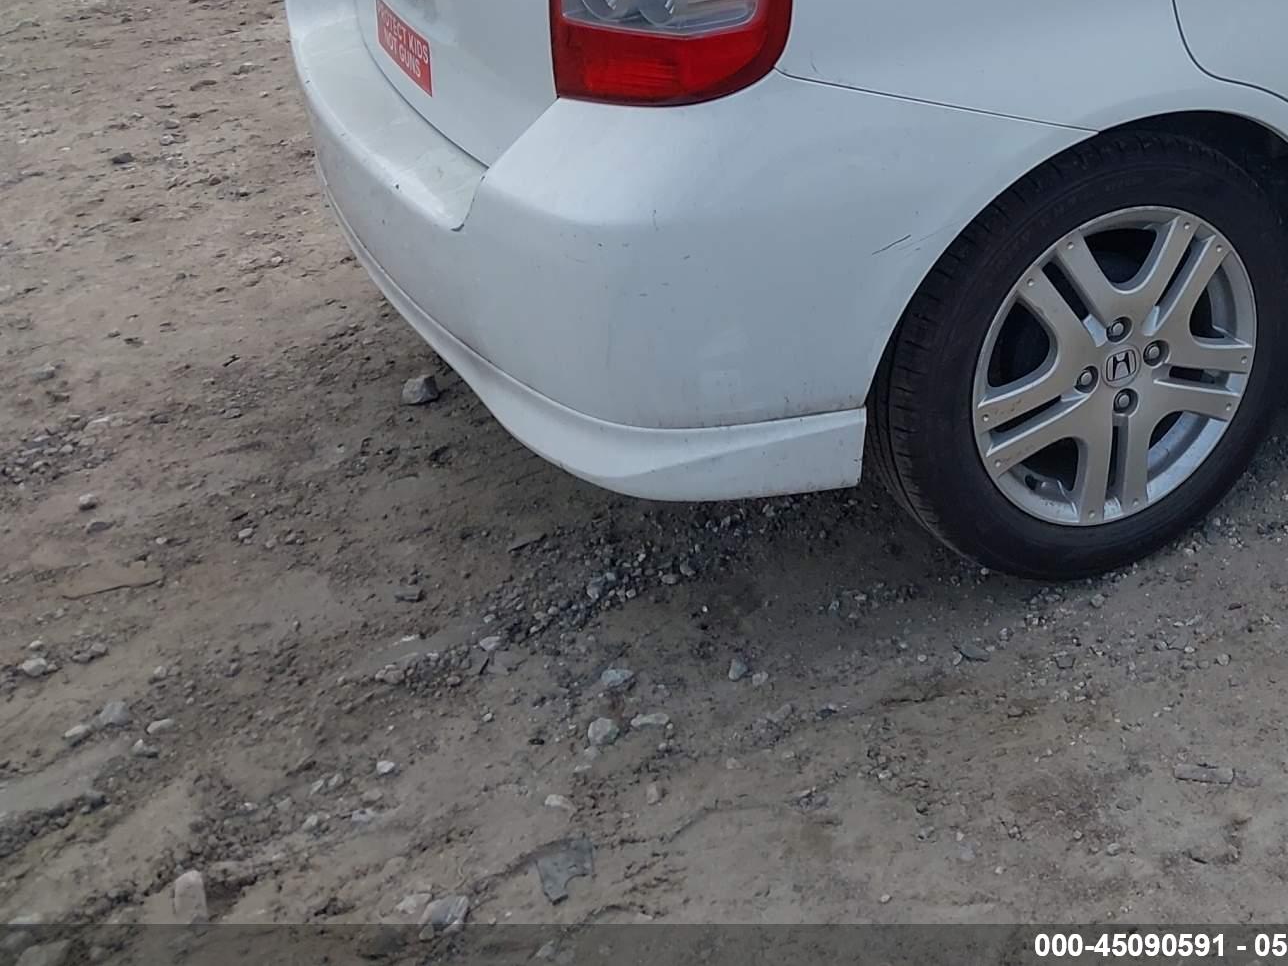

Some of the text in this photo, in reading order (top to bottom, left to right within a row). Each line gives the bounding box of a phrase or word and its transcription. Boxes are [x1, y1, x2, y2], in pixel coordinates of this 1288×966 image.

[384, 27, 420, 77] NOT GUNS
[408, 33, 428, 64] KIDS
